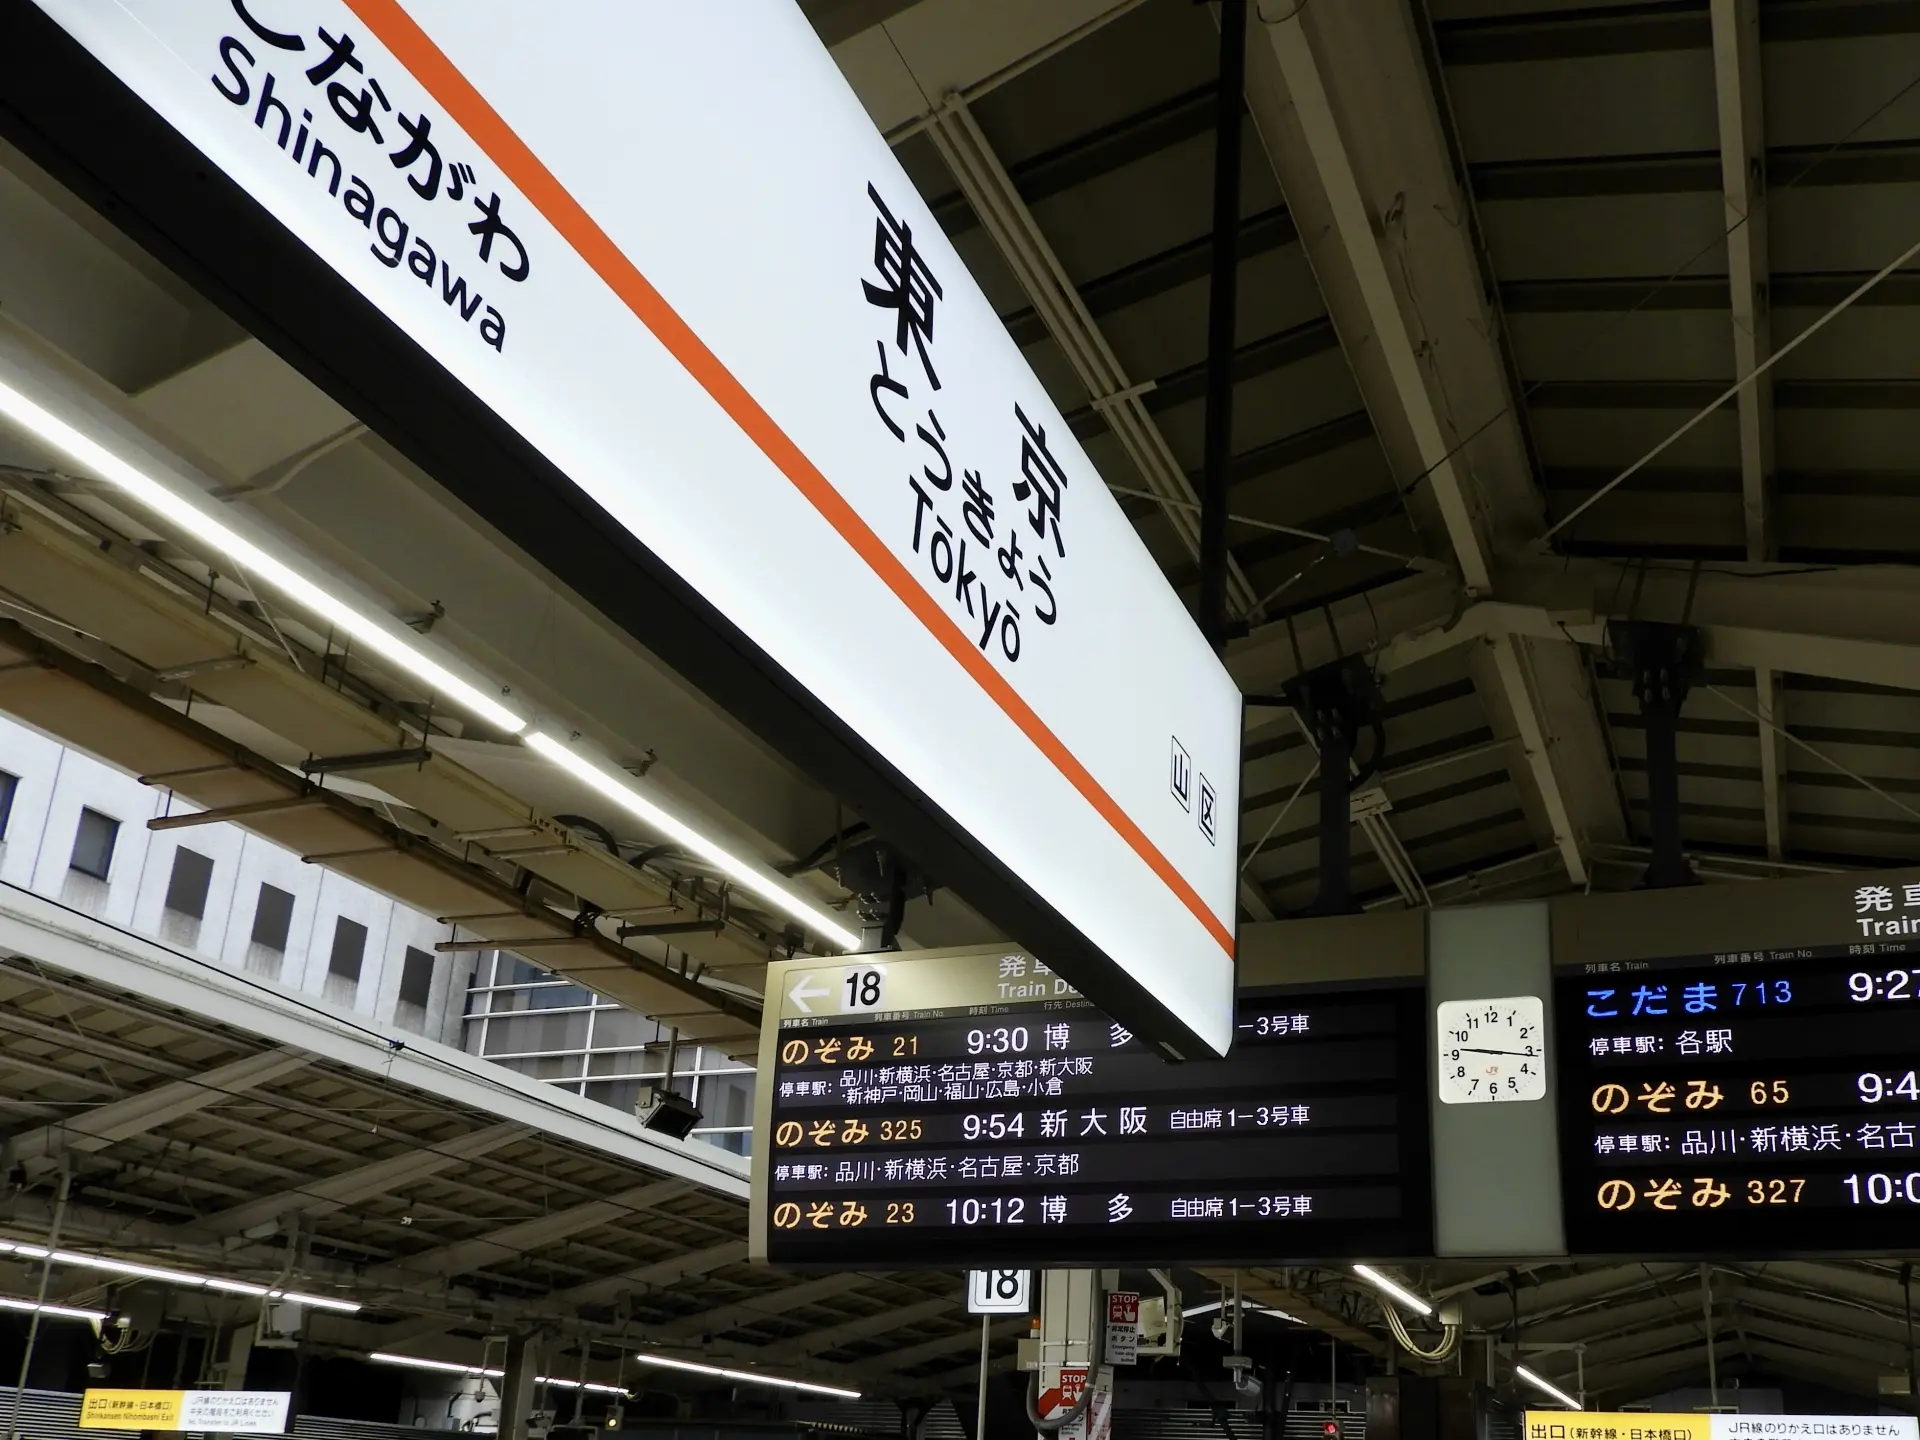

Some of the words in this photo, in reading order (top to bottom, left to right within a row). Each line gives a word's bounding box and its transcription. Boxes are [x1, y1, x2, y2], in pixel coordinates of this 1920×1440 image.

[211, 36, 506, 353] Shinagawa
[860, 180, 1068, 558] 東京
[869, 339, 1057, 625] とうきょう
[908, 473, 1020, 663] Tōkyō
[1856, 915, 1920, 937] Train
[1849, 943, 1875, 955] 時刻
[1879, 943, 1906, 952] Time
[1714, 951, 1764, 964] 列車番号
[1769, 951, 1795, 960] Train
[1585, 962, 1621, 973] 列車名
[1625, 960, 1649, 970] Train
[846, 970, 881, 1007] 18
[997, 981, 1046, 999] Train
[1587, 981, 1717, 1017] こだま
[1731, 979, 1792, 1006] 713
[969, 1005, 988, 1016] 時刻
[1044, 1001, 1063, 1011] 行先
[874, 1011, 909, 1022] 列車番号
[914, 1011, 931, 1019] Train
[1484, 1011, 1498, 1023] 12
[1507, 1016, 1513, 1027] 1
[783, 1018, 809, 1028] 列車名
[811, 1018, 829, 1026] Train
[1467, 1018, 1479, 1029] 11
[1455, 1030, 1468, 1042] 10
[1519, 1027, 1528, 1039] 2
[782, 1036, 875, 1065] のぞみ
[893, 1036, 918, 1056] 21
[967, 1026, 1029, 1055] 9:30
[1675, 1028, 1733, 1054] 各駅
[1451, 1049, 1460, 1061] 9
[1525, 1045, 1533, 1057] 3
[1457, 1066, 1465, 1077] 8
[1485, 1066, 1499, 1074] JR
[1520, 1063, 1529, 1074] 4
[1471, 1079, 1479, 1090] 7
[1489, 1082, 1498, 1094] 6
[1508, 1077, 1516, 1088] 5
[1592, 1080, 1725, 1114] のぞみ
[1750, 1080, 1789, 1105] 65
[775, 1119, 869, 1147] のぞみ
[880, 1119, 922, 1141] 325
[963, 1111, 1025, 1140] 9:54
[1039, 1106, 1148, 1138] 新大阪
[835, 1153, 1080, 1183] 品川・新横浜・名古屋・京都
[1597, 1178, 1731, 1211] のぞみ
[1747, 1179, 1806, 1204] 327
[773, 1201, 868, 1229] のぞみ
[886, 1202, 915, 1224] 23
[946, 1198, 1025, 1225] 10:12
[1040, 1193, 1134, 1224] 博多
[981, 1270, 1018, 1299] 18
[1112, 1294, 1137, 1303] STOP
[1061, 1374, 1087, 1383] STOP
[1728, 1422, 1900, 1437] JR線のりかえ口はありません
